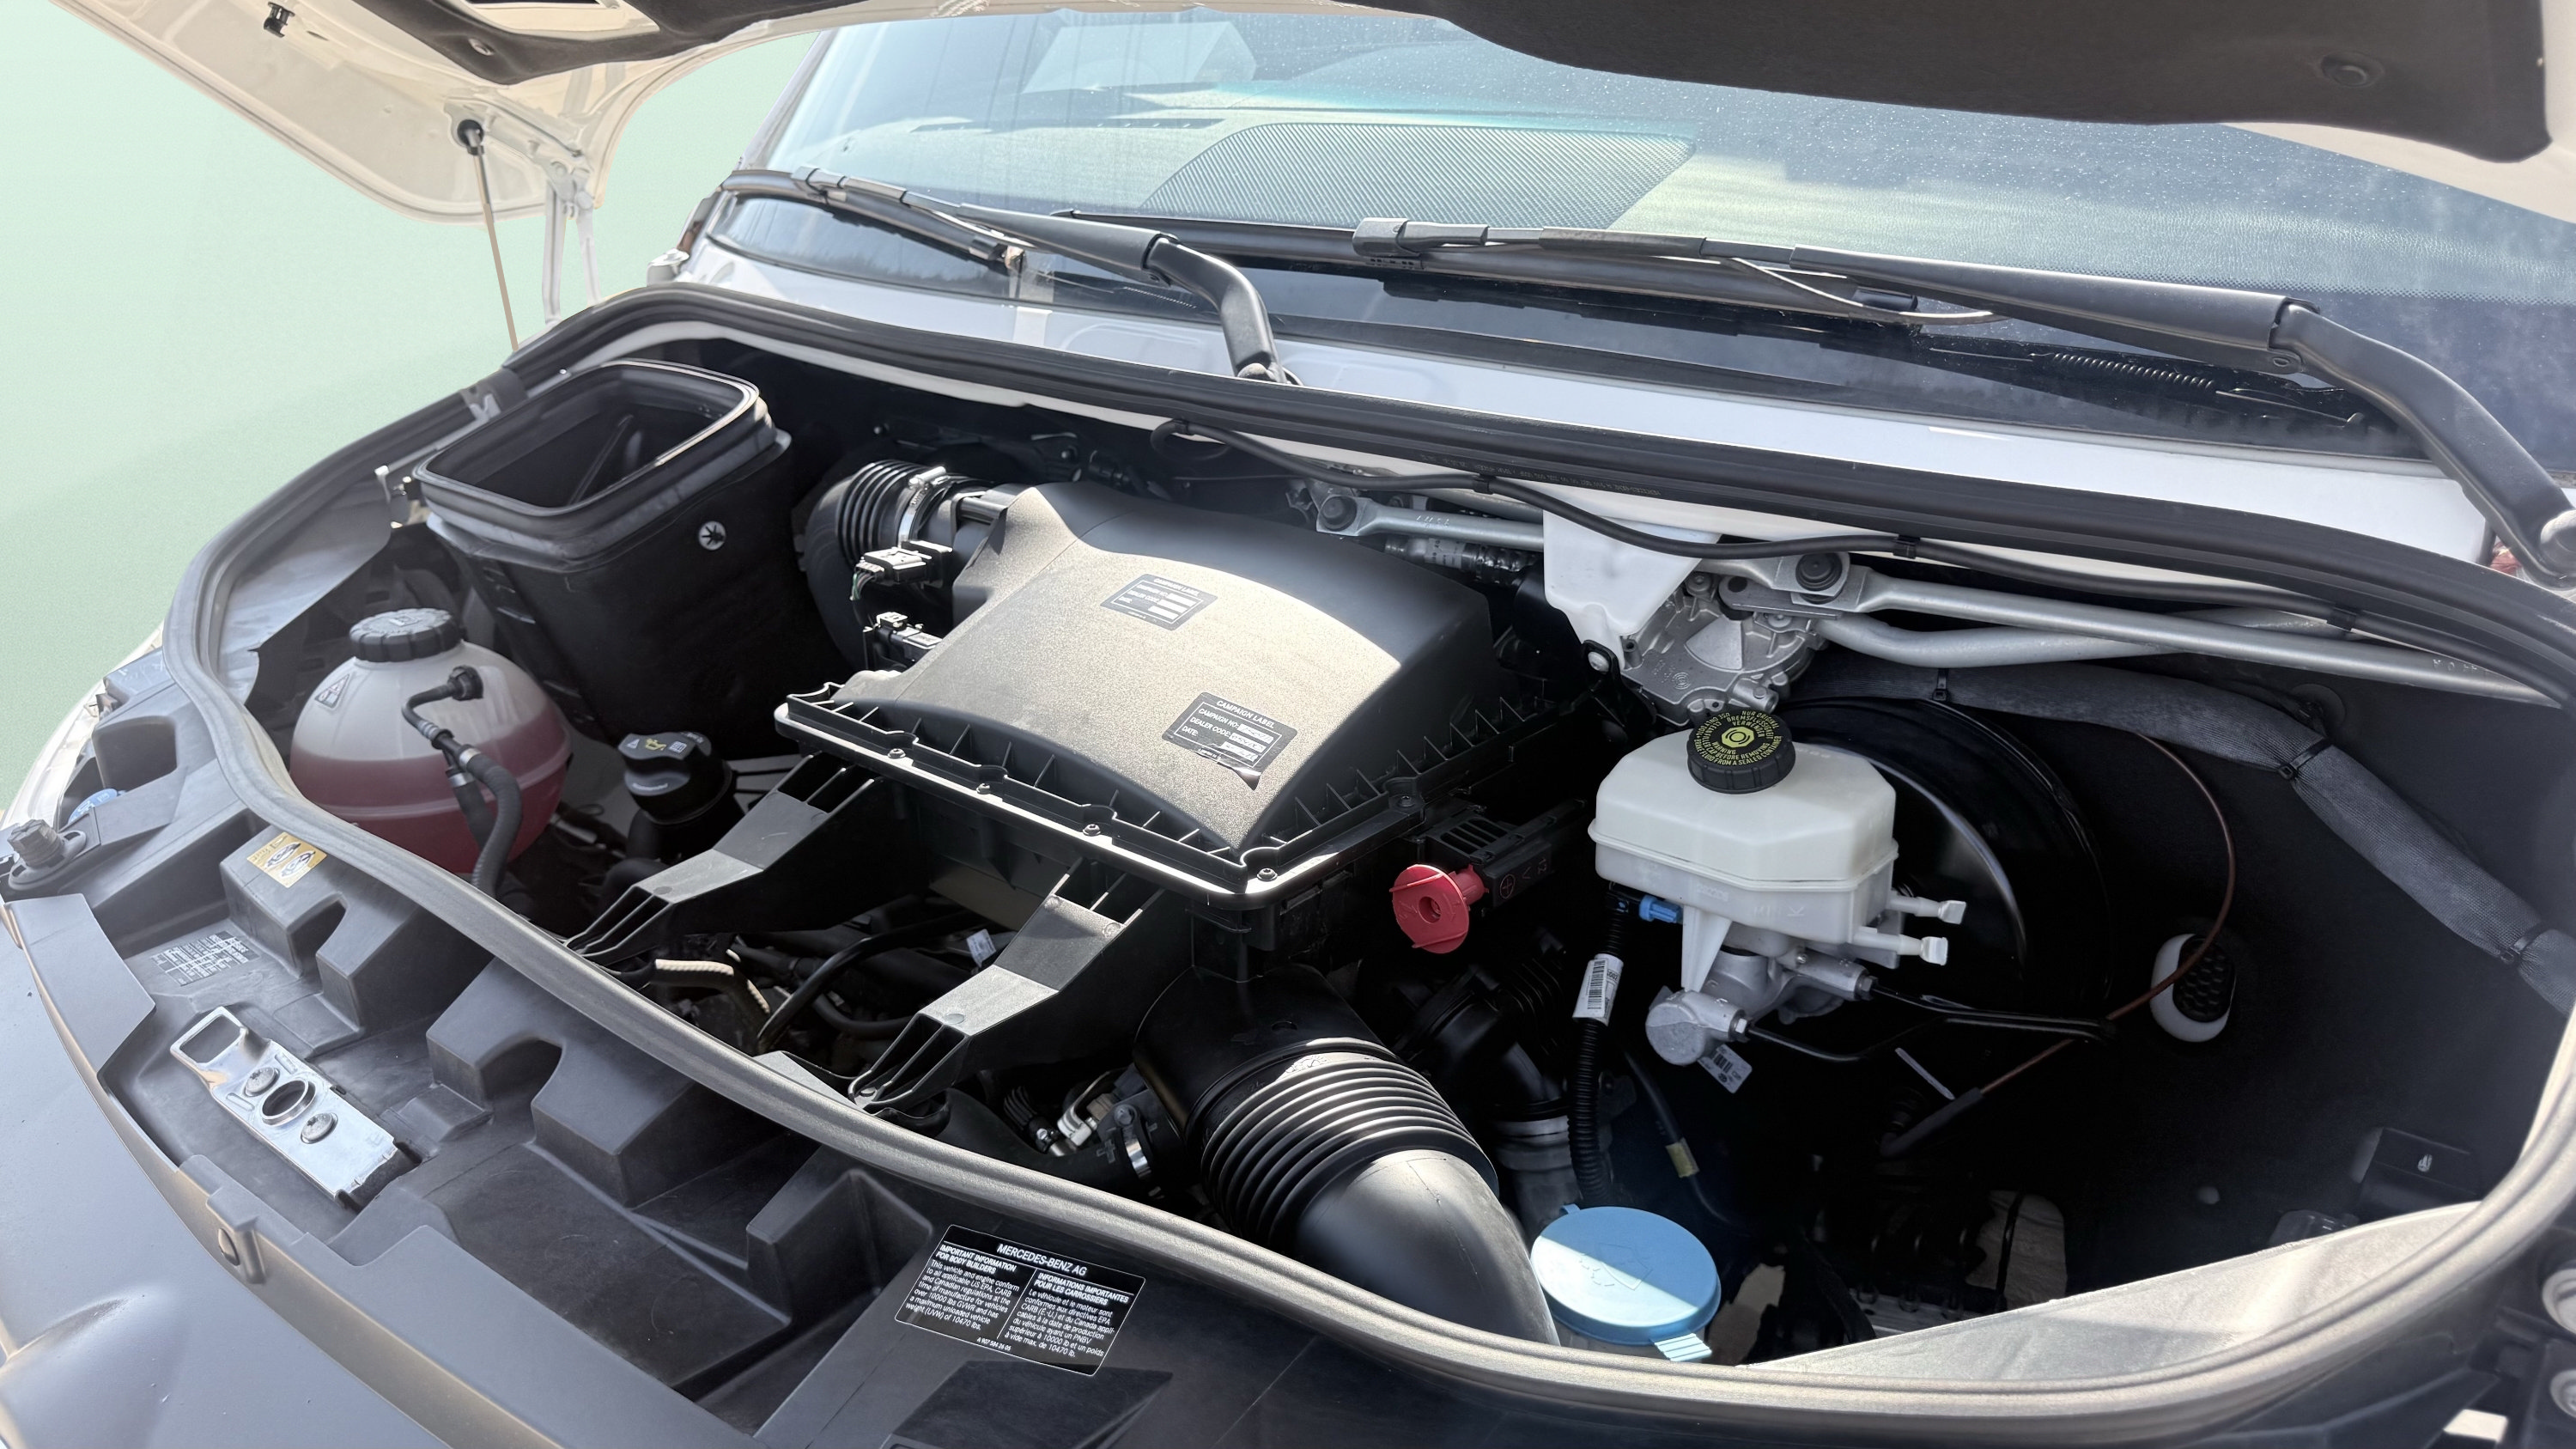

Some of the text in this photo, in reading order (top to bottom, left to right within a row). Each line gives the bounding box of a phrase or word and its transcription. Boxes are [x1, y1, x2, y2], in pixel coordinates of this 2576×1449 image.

[1199, 709, 1239, 728] CAMPAIGN NO:
[1217, 701, 1274, 728] CAMPAIGN LABEL
[1182, 726, 1198, 736] DATE:
[1190, 717, 1213, 729] DEALER
[1212, 727, 1230, 737] CODE:
[1712, 741, 1736, 754] WARNING
[1739, 755, 1761, 765] SEALED
[936, 1251, 996, 1274] FOR BODY BUILDERS
[940, 1245, 1016, 1271] IMPORTANT INFORMATION
[998, 1245, 1087, 1275] MERCEDES-BENZ AG
[932, 1259, 943, 1269] This
[944, 1266, 963, 1275] vehicle
[975, 1275, 994, 1284] engine
[995, 1281, 1019, 1291] conform
[942, 1273, 970, 1285] applicable
[995, 1288, 1012, 1297] CARB
[919, 1282, 932, 1290] time
[939, 1288, 974, 1302] manufacture
[985, 1302, 1008, 1312] vehicles
[934, 1278, 960, 1290] Canadian
[961, 1287, 993, 1300] regulations
[1034, 1280, 1052, 1289] POUR
[1065, 1288, 1108, 1305] CARROSSIERS
[1038, 1273, 1128, 1302] INFORMATIONS IMPORTANTES
[915, 1298, 942, 1309] maximum
[943, 1306, 970, 1318] unloaded
[970, 1314, 990, 1324] vehicle
[929, 1293, 947, 1302] 10000
[957, 1300, 975, 1311] GVWR
[1025, 1297, 1055, 1310] conformes
[1068, 1309, 1097, 1321] directives
[1097, 1316, 1110, 1324] EPA
[1038, 1293, 1061, 1303] véhicule
[1076, 1304, 1097, 1313] moteur
[906, 1303, 925, 1312] weight
[925, 1308, 944, 1319] (UVW)
[952, 1316, 971, 1326] 10470
[1017, 1312, 1036, 1320] cables
[1071, 1327, 1104, 1339] production
[1021, 1303, 1038, 1312] CARB
[1074, 1318, 1097, 1330] Canada
[1097, 1325, 1115, 1334] appli-
[1009, 1325, 1036, 1336] supérieur
[1044, 1335, 1063, 1344] 10000
[1086, 1348, 1103, 1356] poids
[1023, 1321, 1046, 1331] véhicule
[1047, 1328, 1064, 1336] ayant
[1073, 1334, 1091, 1343] PNBV
[1049, 1344, 1068, 1355] 10470
